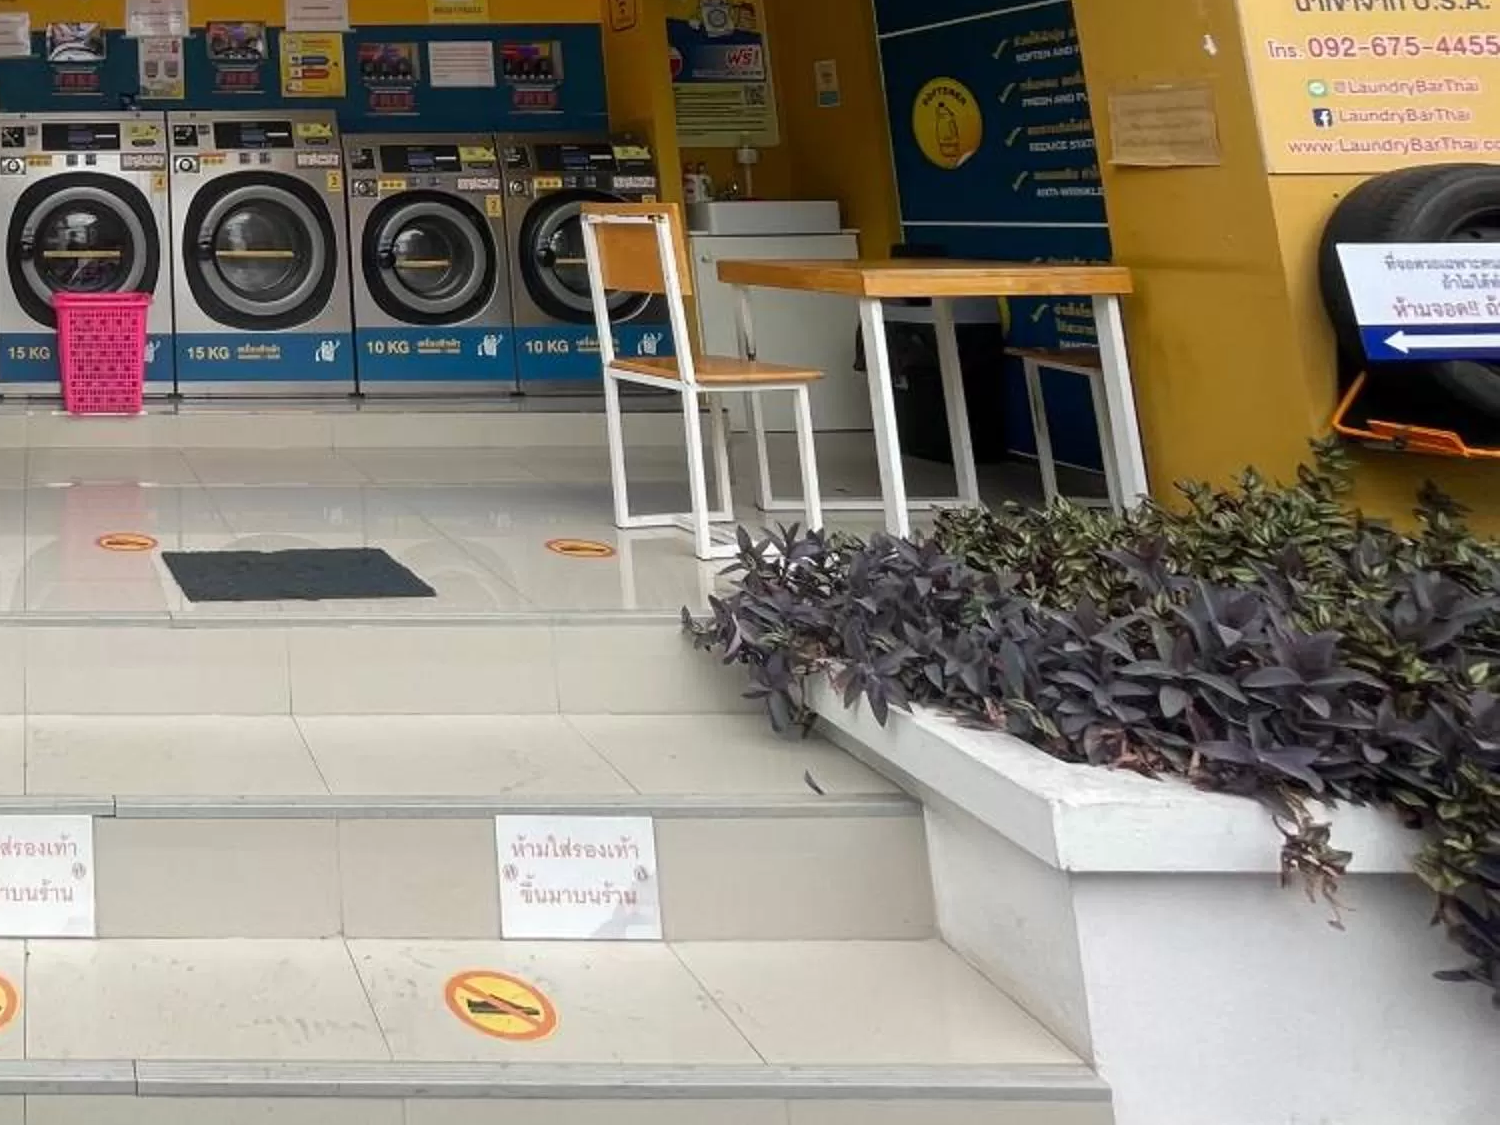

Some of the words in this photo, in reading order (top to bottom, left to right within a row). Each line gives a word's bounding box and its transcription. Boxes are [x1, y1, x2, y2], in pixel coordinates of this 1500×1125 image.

[1267, 39, 1303, 59] โทร.
[1307, 35, 1500, 58] 092-675-4455
[7, 346, 26, 359] 15
[28, 346, 51, 359] KG
[187, 346, 206, 359] 15
[208, 346, 230, 359] KG
[366, 341, 385, 354] 10
[386, 341, 410, 354] KG
[525, 340, 544, 353] 10
[547, 340, 569, 353] KG
[510, 834, 640, 860] ห้ามใส่รองเท้า
[519, 873, 638, 906] ขึ้นมาบนร้าน
